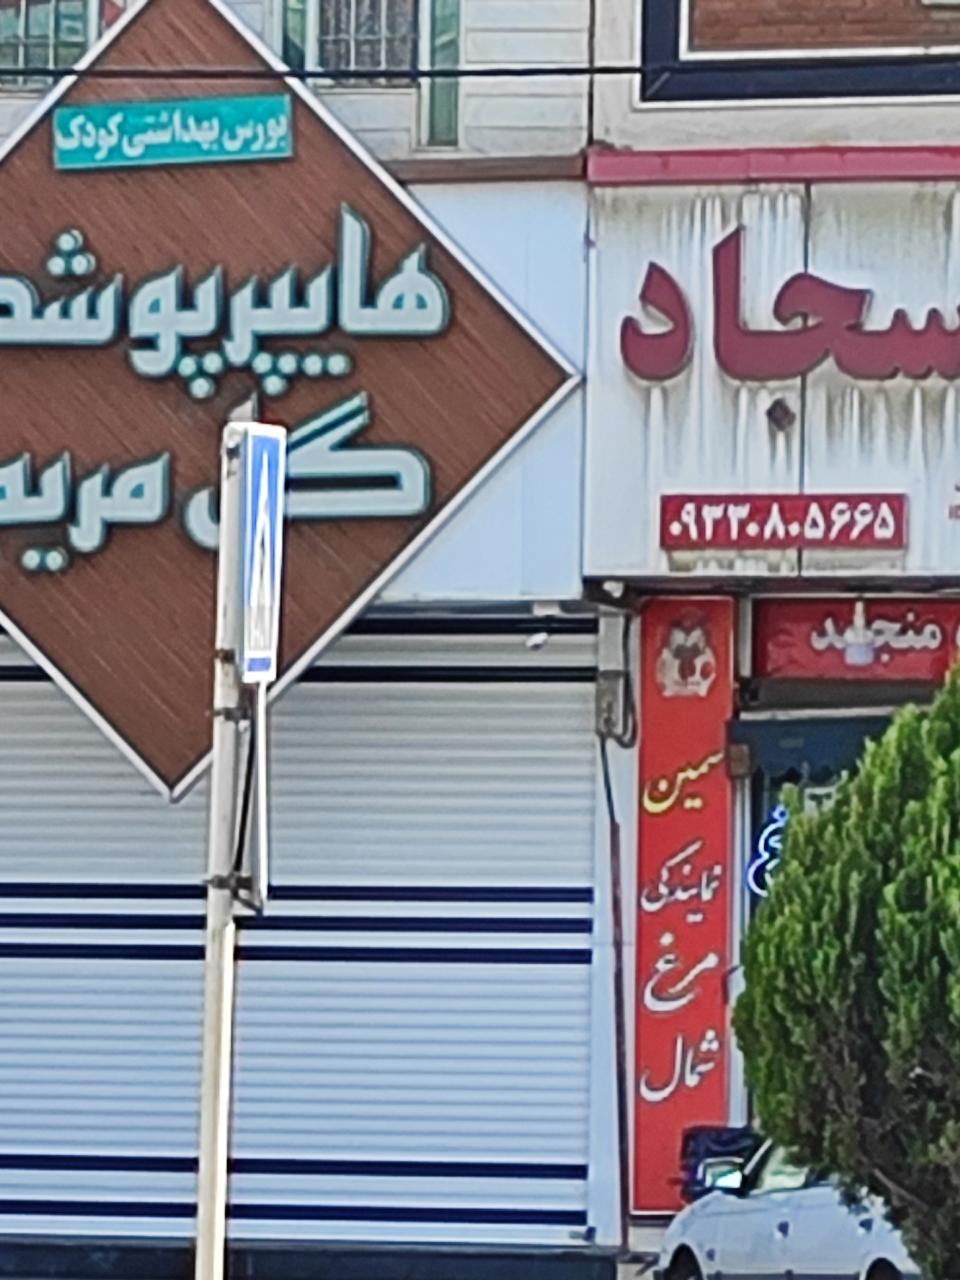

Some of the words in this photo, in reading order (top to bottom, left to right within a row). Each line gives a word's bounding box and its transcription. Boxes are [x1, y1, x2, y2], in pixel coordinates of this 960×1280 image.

[54, 112, 125, 161] کودک
[643, 932, 720, 1012] مرغ
[640, 1028, 720, 1102] شمال
